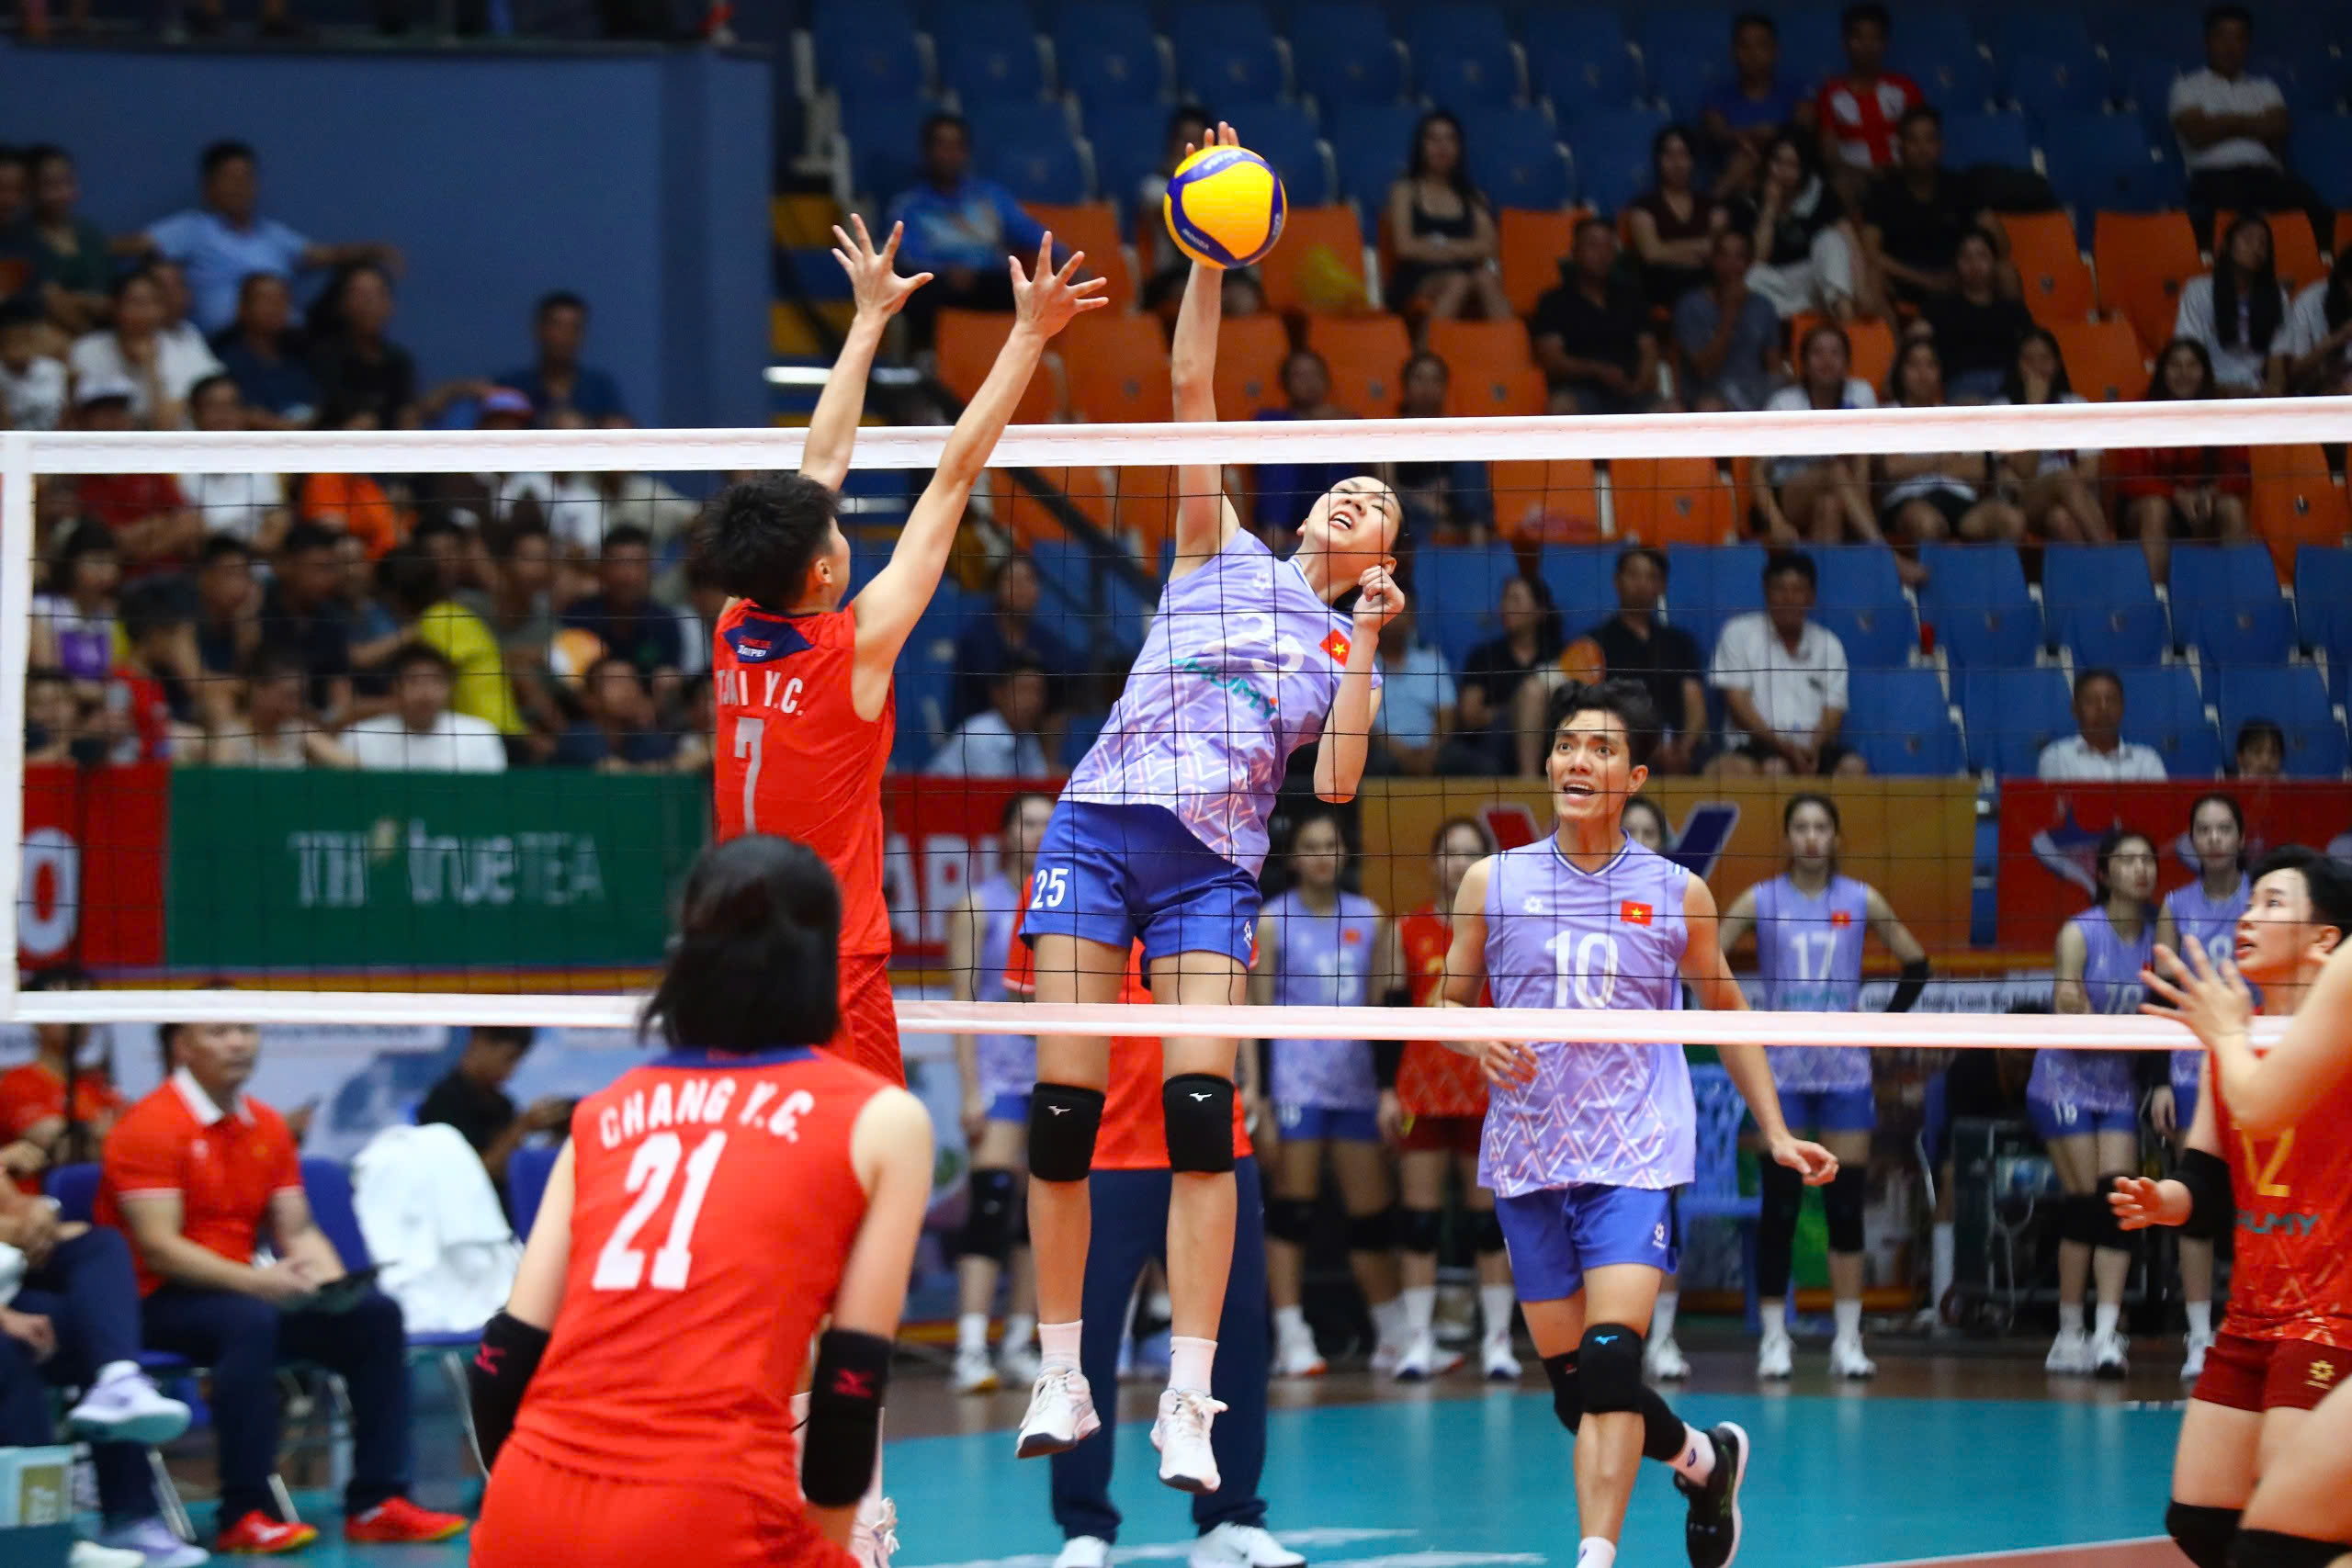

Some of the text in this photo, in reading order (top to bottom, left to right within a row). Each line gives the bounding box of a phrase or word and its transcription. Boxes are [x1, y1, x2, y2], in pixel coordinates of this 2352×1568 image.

[763, 670, 804, 716] Y.C.
[734, 716, 765, 834] 7
[1031, 868, 1069, 909] 25
[1545, 930, 1619, 1009] 10
[1791, 931, 1837, 986] 17
[600, 1077, 737, 1149] CHANG
[592, 1129, 728, 1292] 21
